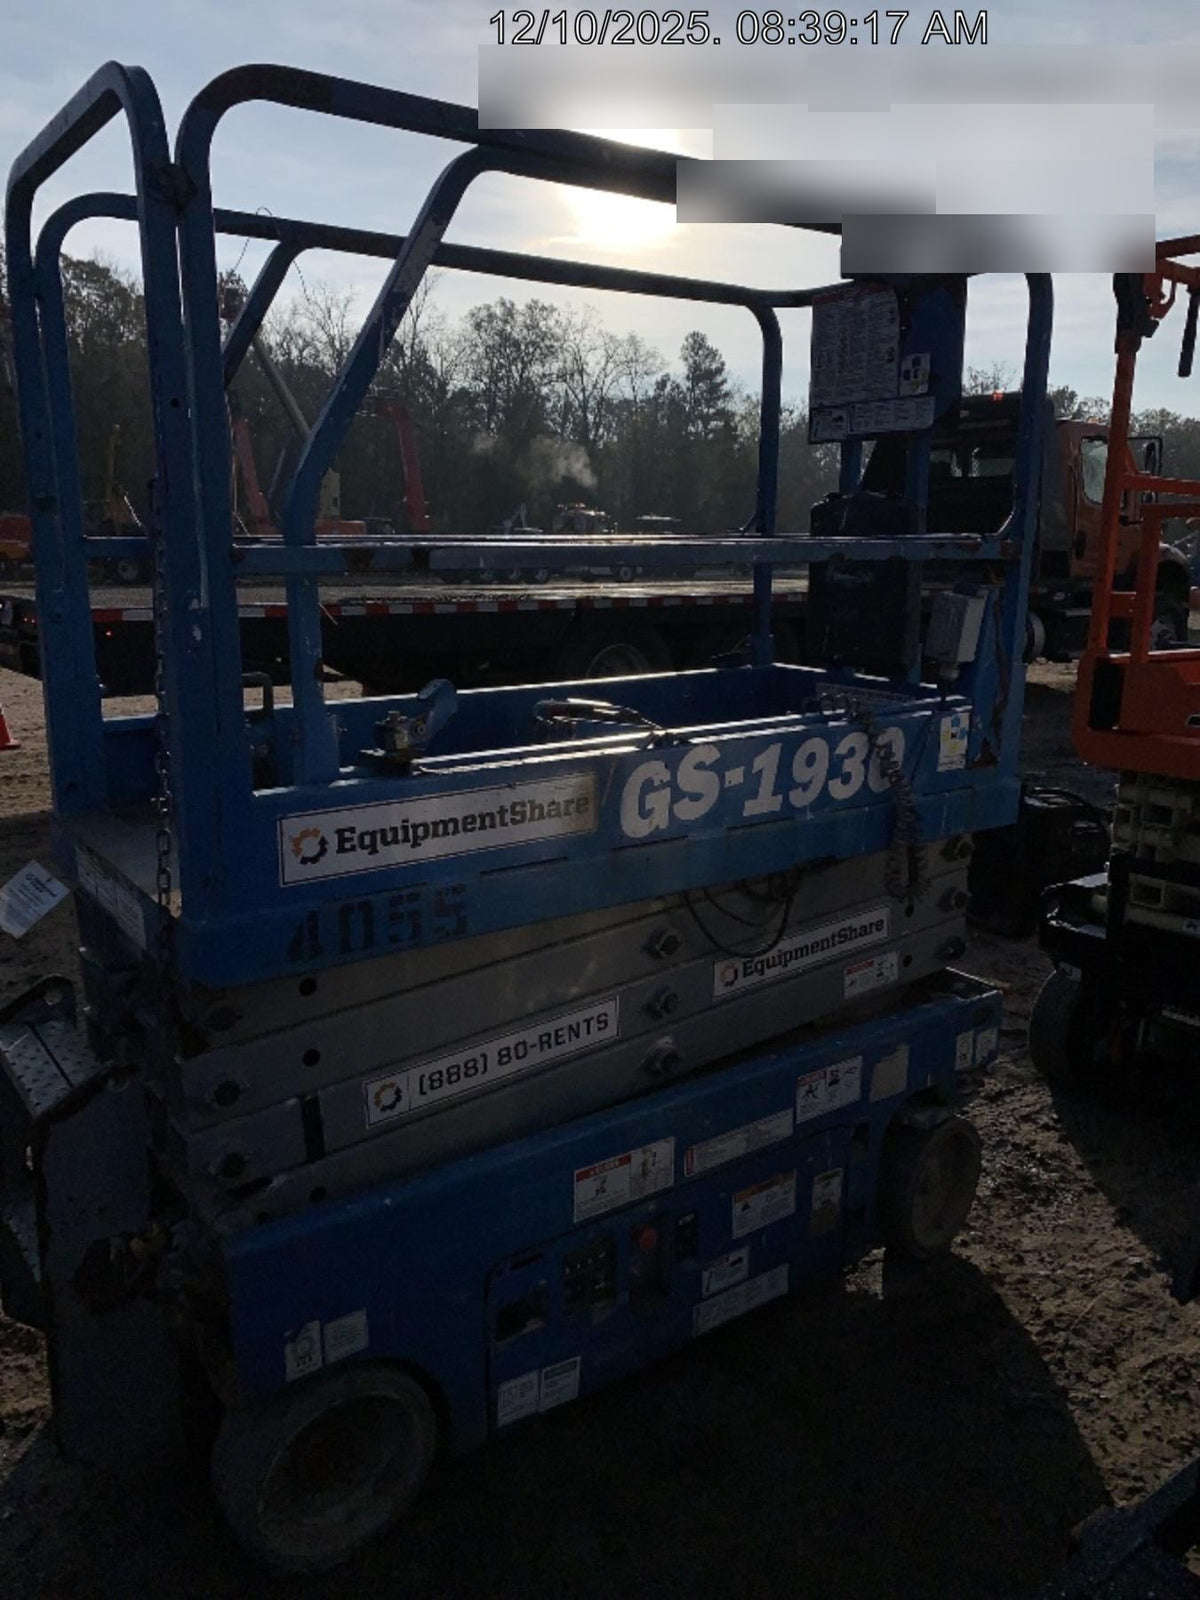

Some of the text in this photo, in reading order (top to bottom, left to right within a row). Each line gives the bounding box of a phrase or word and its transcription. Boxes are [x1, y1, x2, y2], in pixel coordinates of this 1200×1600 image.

[620, 727, 905, 838] GS-1930
[335, 795, 590, 855] EquipmentShare
[743, 918, 885, 978] EquipmentShare
[420, 1013, 609, 1095] (888) 80-RENTS
